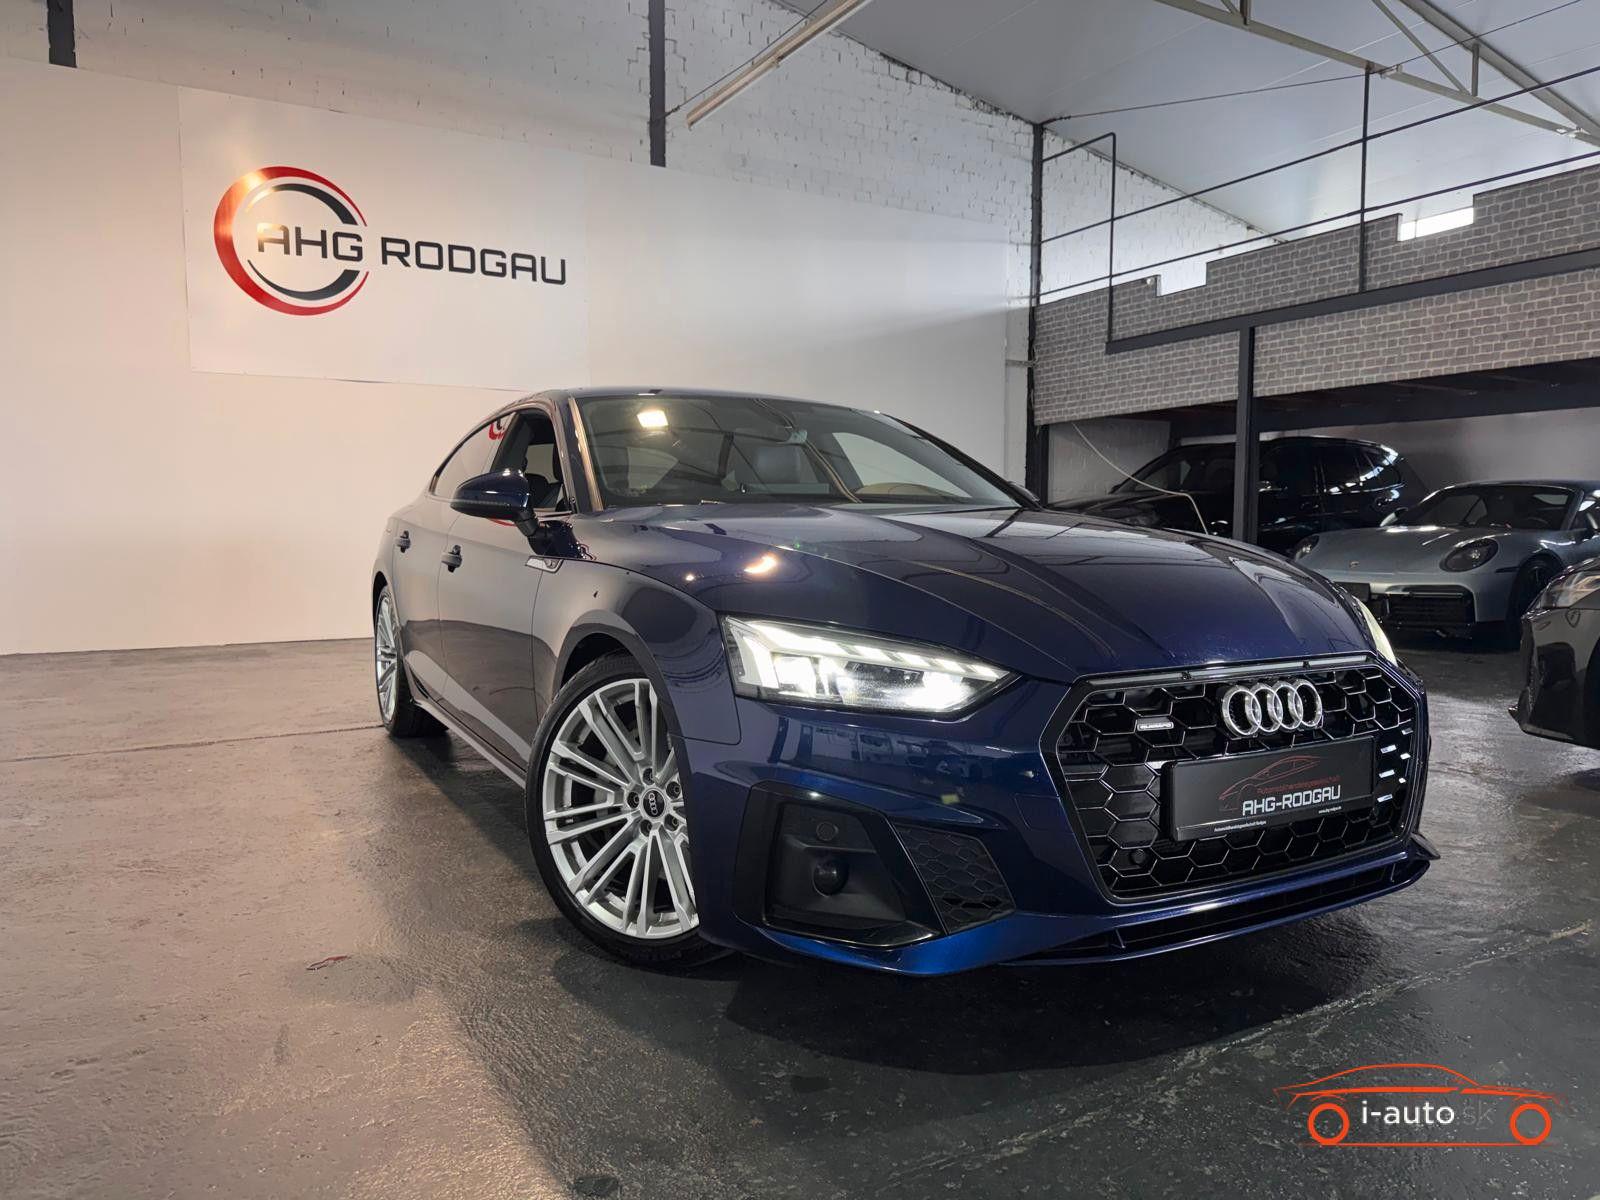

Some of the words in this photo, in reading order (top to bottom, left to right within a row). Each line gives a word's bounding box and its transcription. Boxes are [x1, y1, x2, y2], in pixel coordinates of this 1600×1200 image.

[256, 222, 363, 263] AHG
[380, 236, 566, 286] RODGAU
[1242, 785, 1341, 816] AHG-RODGAU
